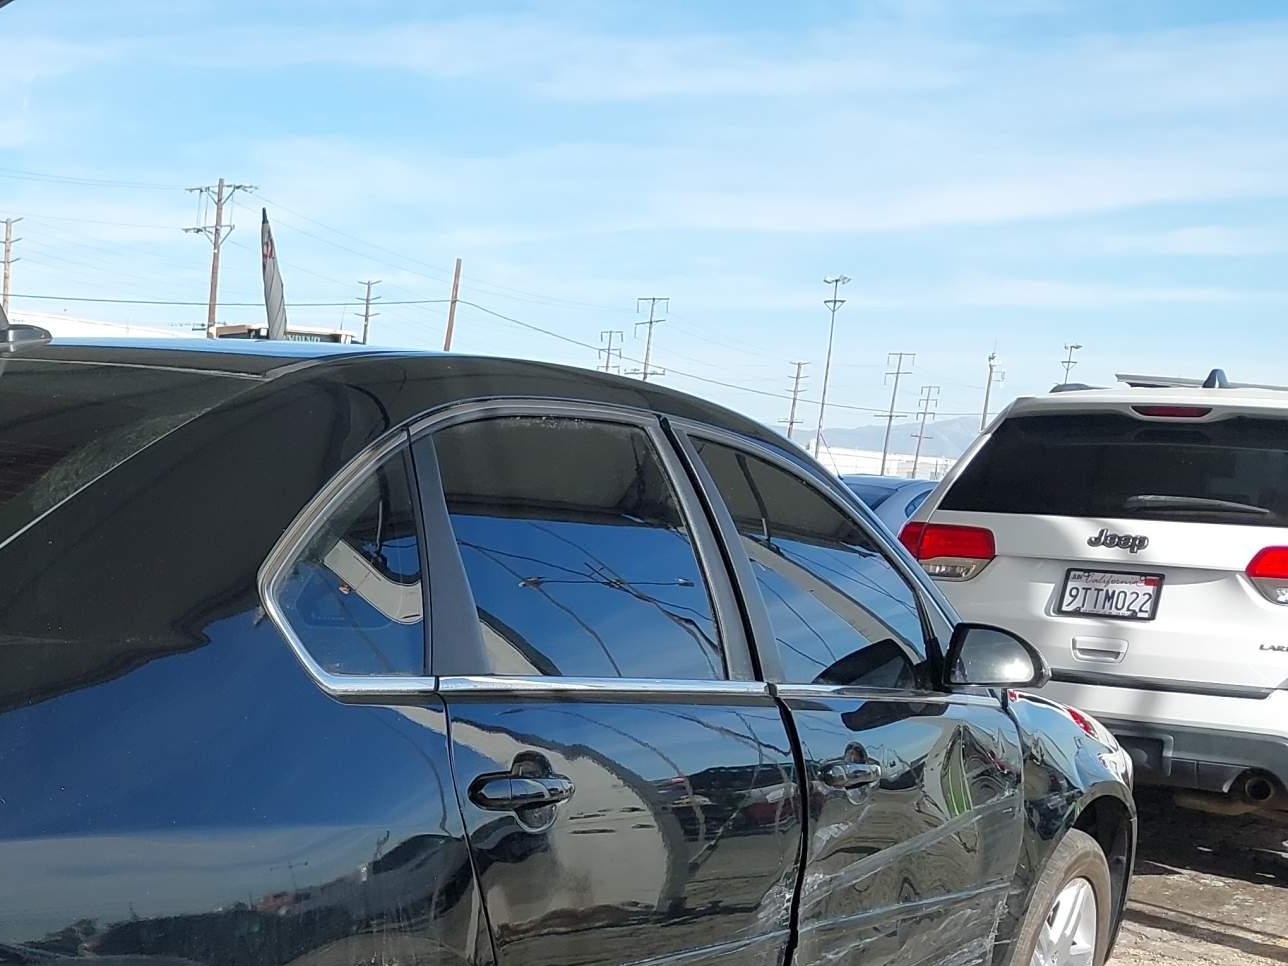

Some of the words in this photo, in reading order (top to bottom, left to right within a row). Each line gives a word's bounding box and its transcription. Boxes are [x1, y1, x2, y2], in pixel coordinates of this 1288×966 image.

[1086, 528, 1150, 554] Jeep
[1064, 586, 1153, 614] 9TTM022
[1258, 643, 1288, 653] LAR
